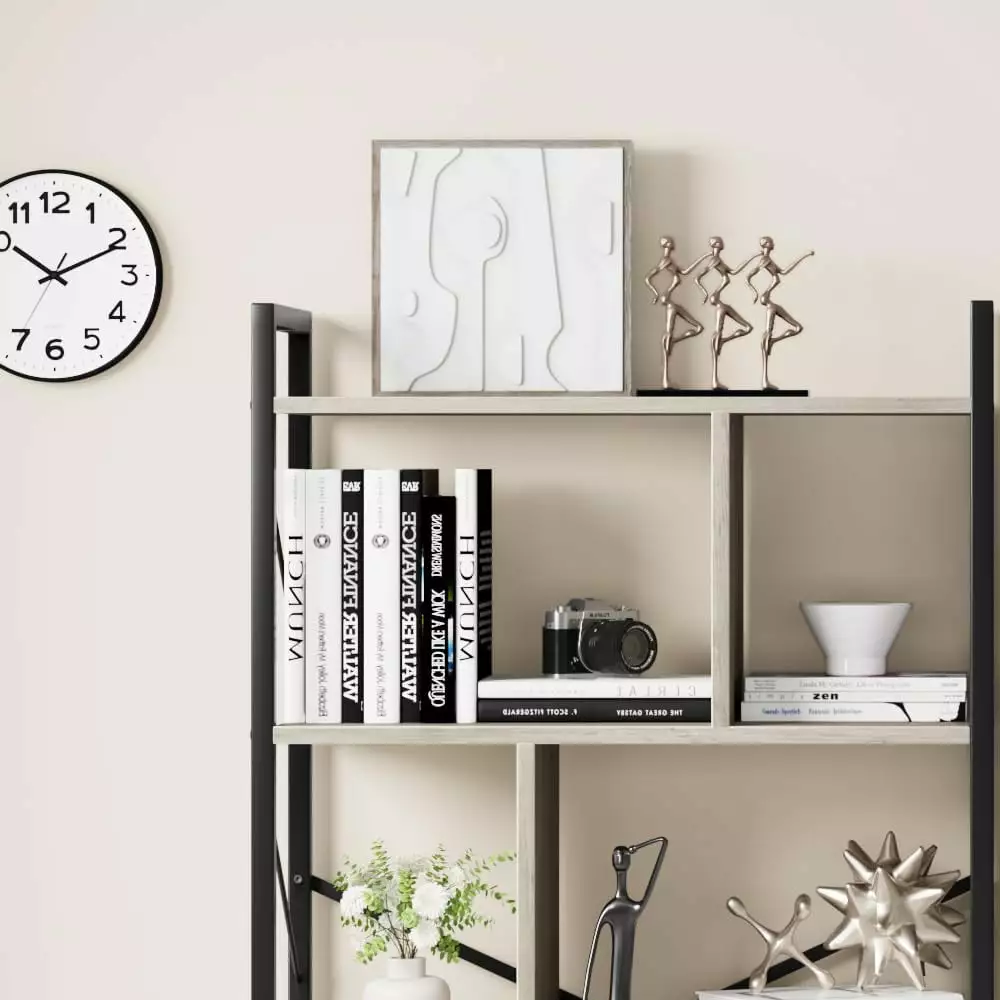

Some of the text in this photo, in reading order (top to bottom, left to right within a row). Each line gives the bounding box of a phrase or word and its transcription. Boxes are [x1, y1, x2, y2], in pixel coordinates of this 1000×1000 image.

[8, 202, 30, 224] 11
[38, 191, 70, 214] 12
[86, 202, 95, 224] 1
[108, 228, 126, 250] 2
[120, 264, 138, 286] 3
[108, 300, 126, 322] 4
[11, 328, 31, 351] 7
[45, 338, 64, 360] 6
[84, 328, 100, 350] 5
[812, 692, 839, 700] zen
